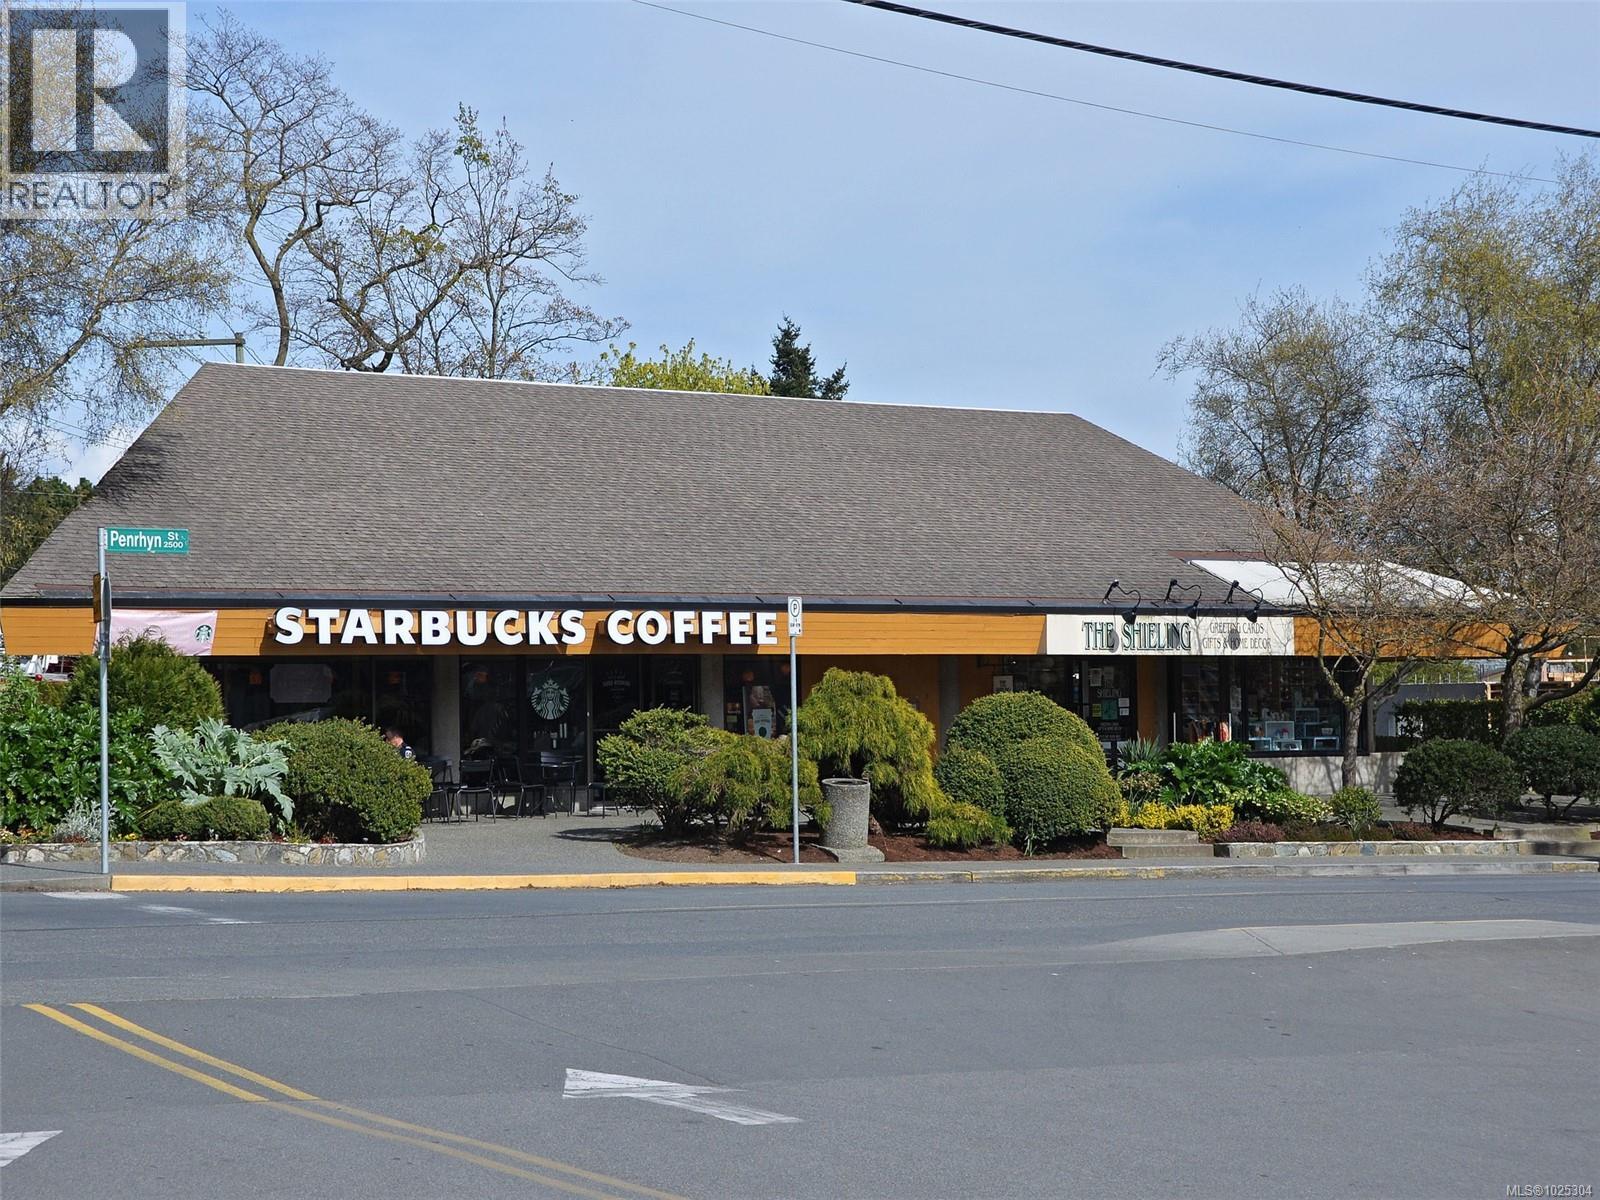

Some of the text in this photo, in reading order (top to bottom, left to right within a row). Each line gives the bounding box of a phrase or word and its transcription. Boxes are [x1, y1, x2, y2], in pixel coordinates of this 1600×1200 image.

[110, 531, 179, 551] Penrhyn St
[274, 606, 587, 646] STARBUCKS
[607, 609, 778, 645] COFFEE
[1209, 622, 1265, 634] GREETING CARDS
[1082, 622, 1192, 651] THE SHIELING
[1202, 638, 1221, 649] GIFTS
[1250, 638, 1272, 650] DECOR
